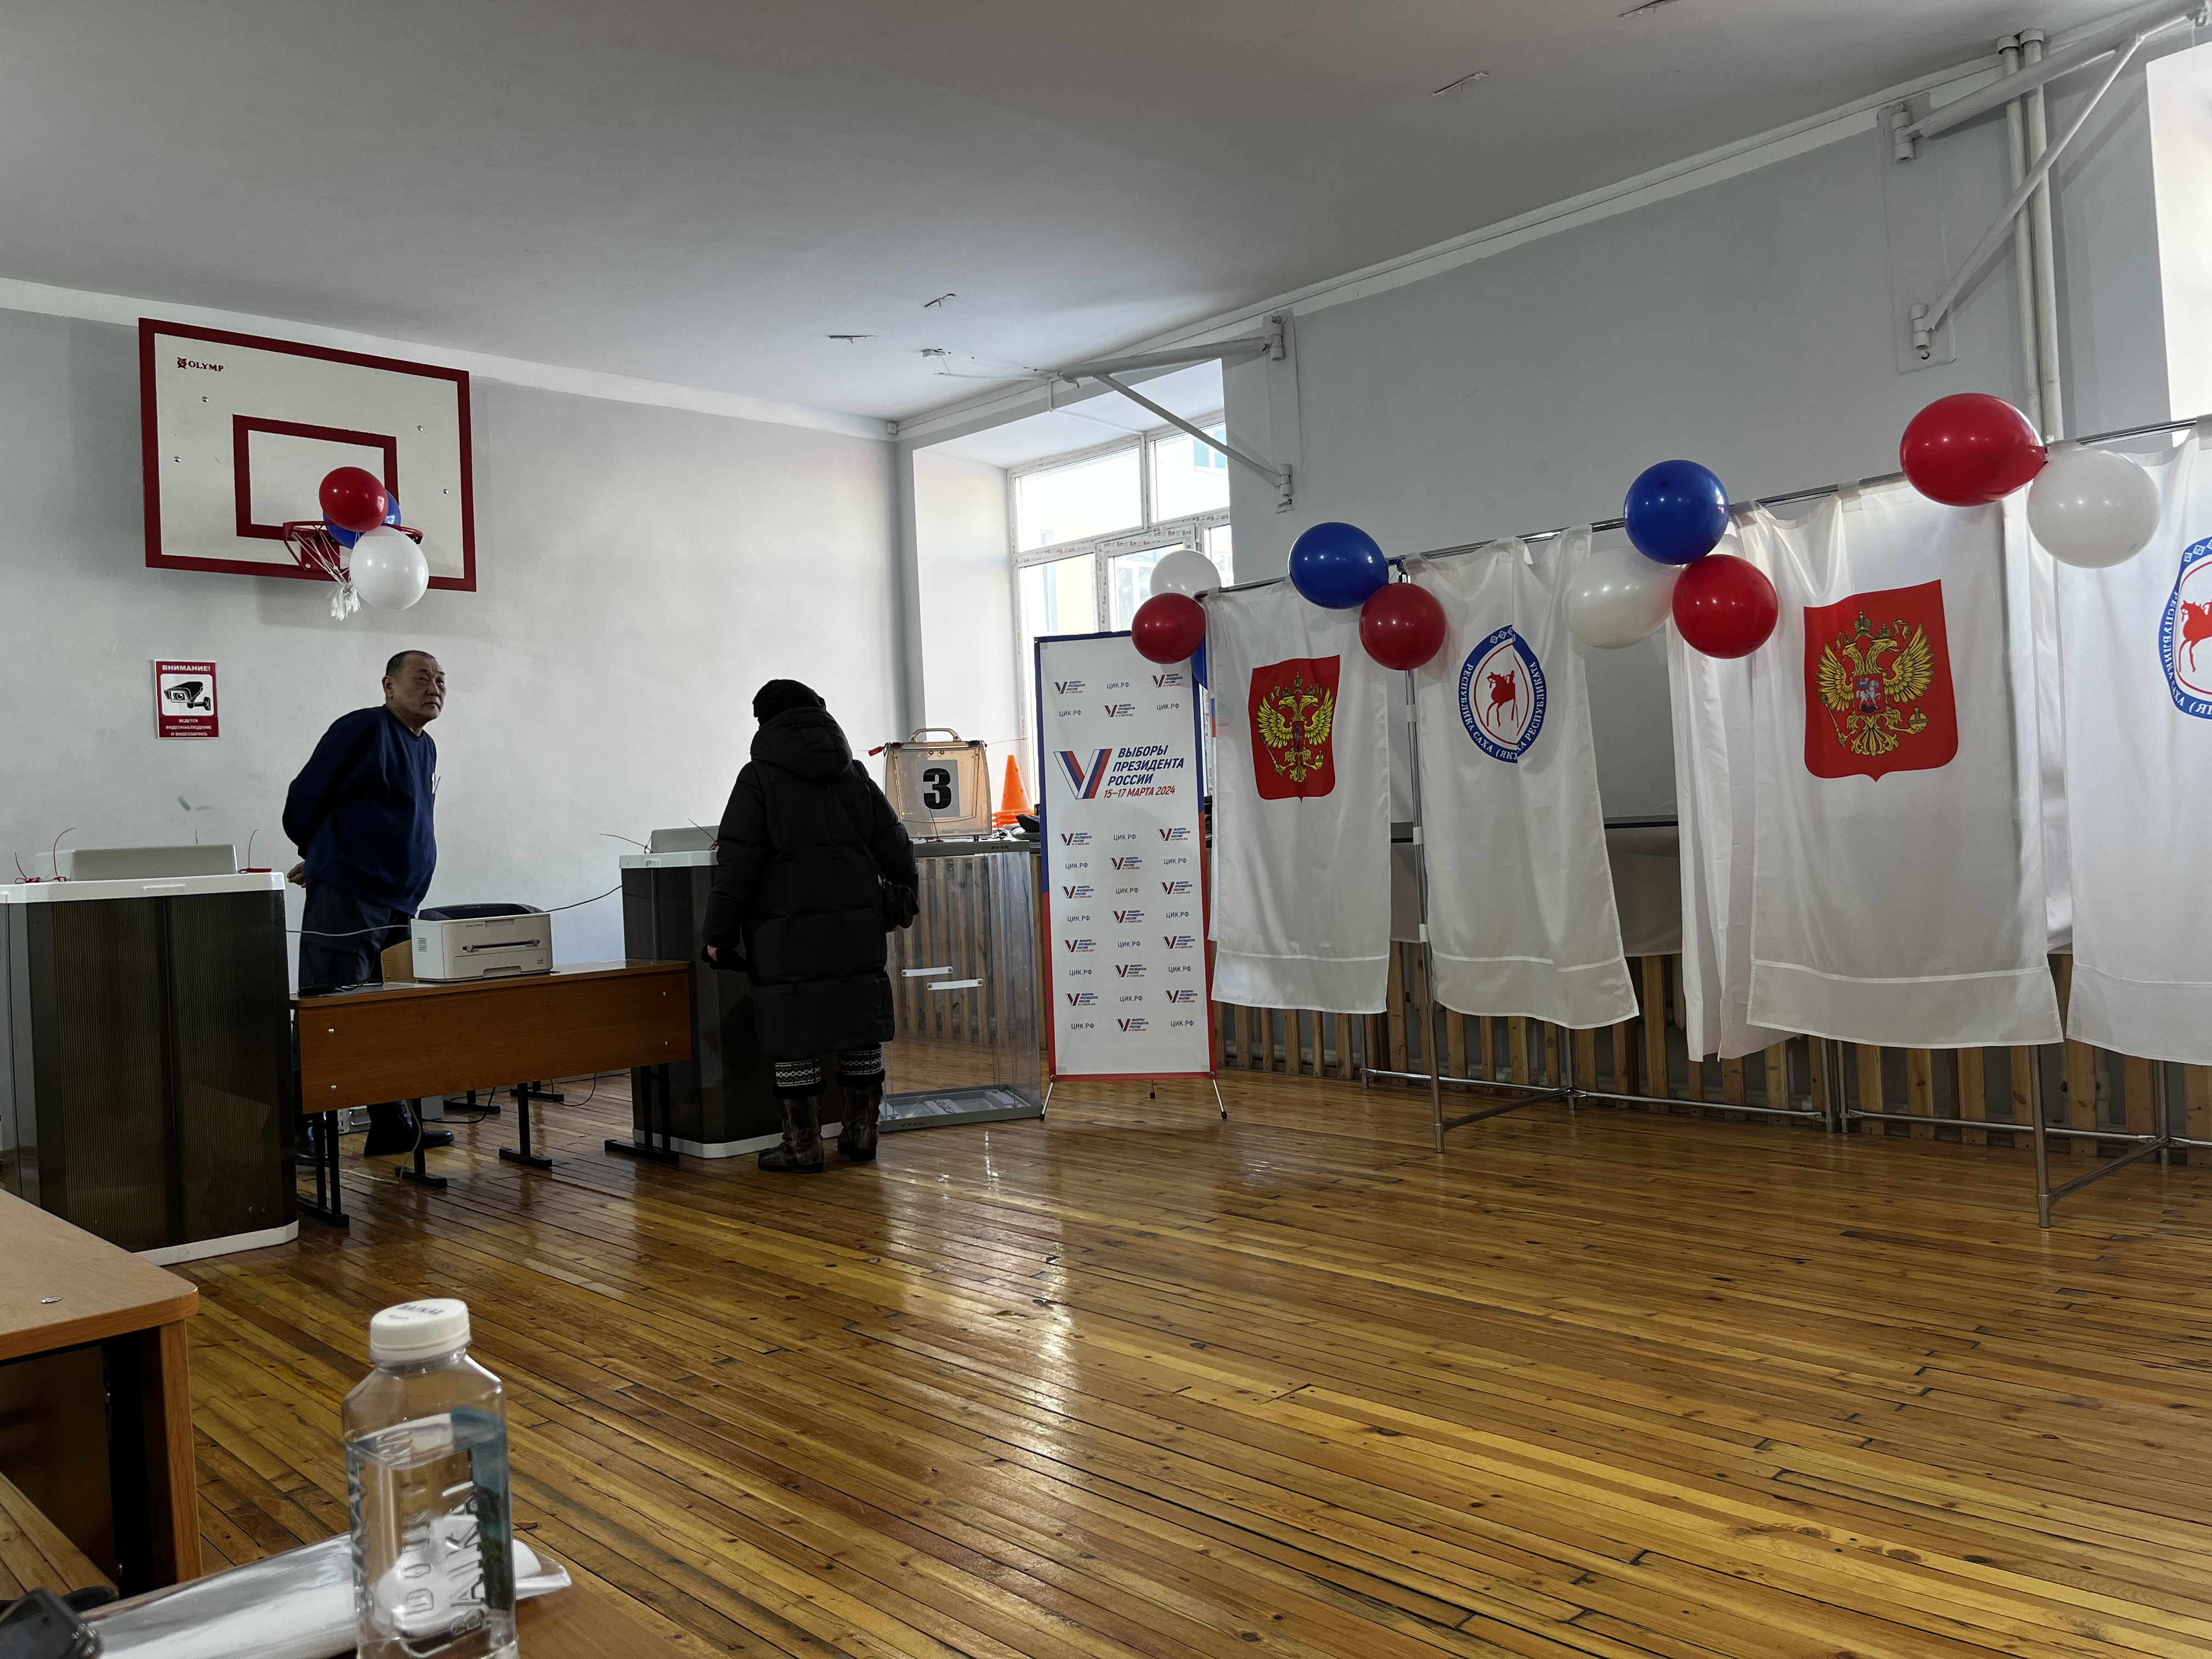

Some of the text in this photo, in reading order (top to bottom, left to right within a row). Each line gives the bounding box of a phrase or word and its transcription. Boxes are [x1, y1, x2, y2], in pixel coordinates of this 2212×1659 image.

[188, 360, 224, 371] OLYMP
[1107, 681, 1130, 690] ЦИК.РФ
[1524, 661, 1544, 741] РЕСПУБЛИКАТА
[1460, 663, 1474, 731] РЕСПУБЛИКА
[1473, 731, 1493, 753] САХА
[1118, 744, 1169, 758] ВЫБОРЫ
[1112, 758, 1184, 772] ПРЕЗИДЕНТА
[1107, 774, 1154, 786] РОССИИ
[923, 768, 952, 810] 3
[1126, 787, 1154, 797] МАРТА
[1155, 786, 1176, 795] 2024
[1164, 857, 1187, 865] ЦИК.РФ
[1166, 911, 1189, 919] ЦИК.РФ
